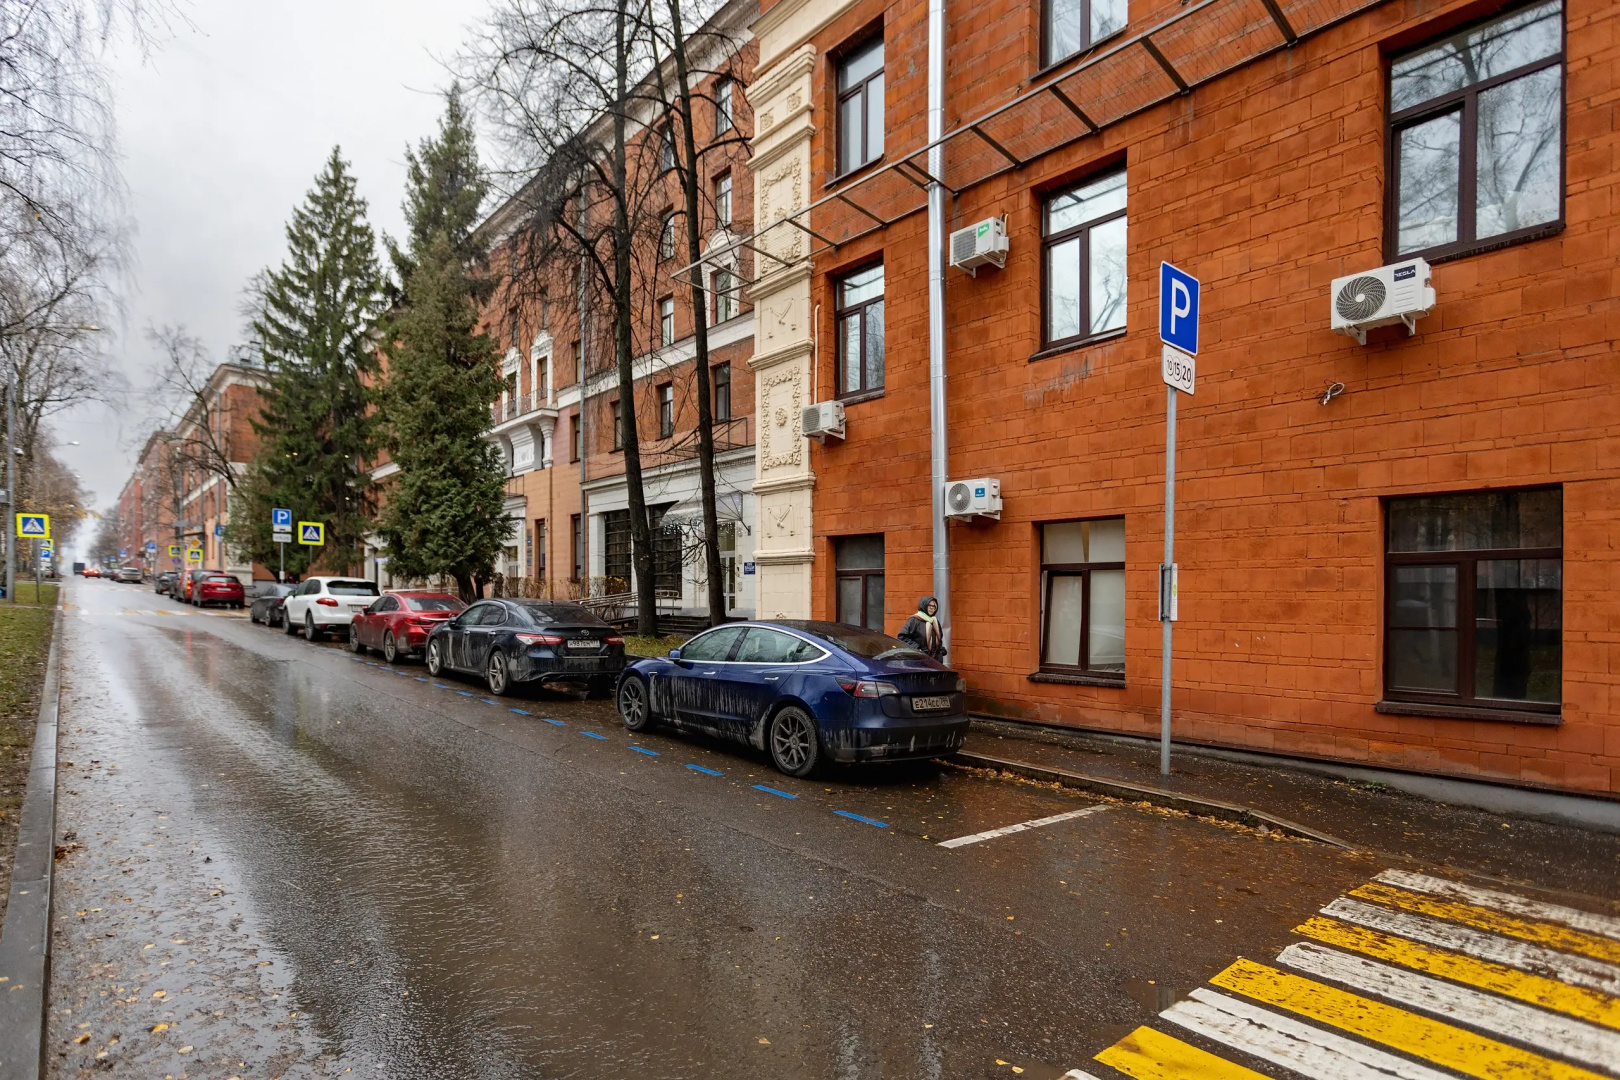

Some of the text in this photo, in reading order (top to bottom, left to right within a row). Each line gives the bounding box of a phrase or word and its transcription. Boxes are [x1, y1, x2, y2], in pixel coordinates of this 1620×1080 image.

[1394, 269, 1416, 277] TESLA
[1171, 277, 1191, 335] P
[1167, 359, 1192, 383] 10 15 20
[277, 511, 288, 524] P
